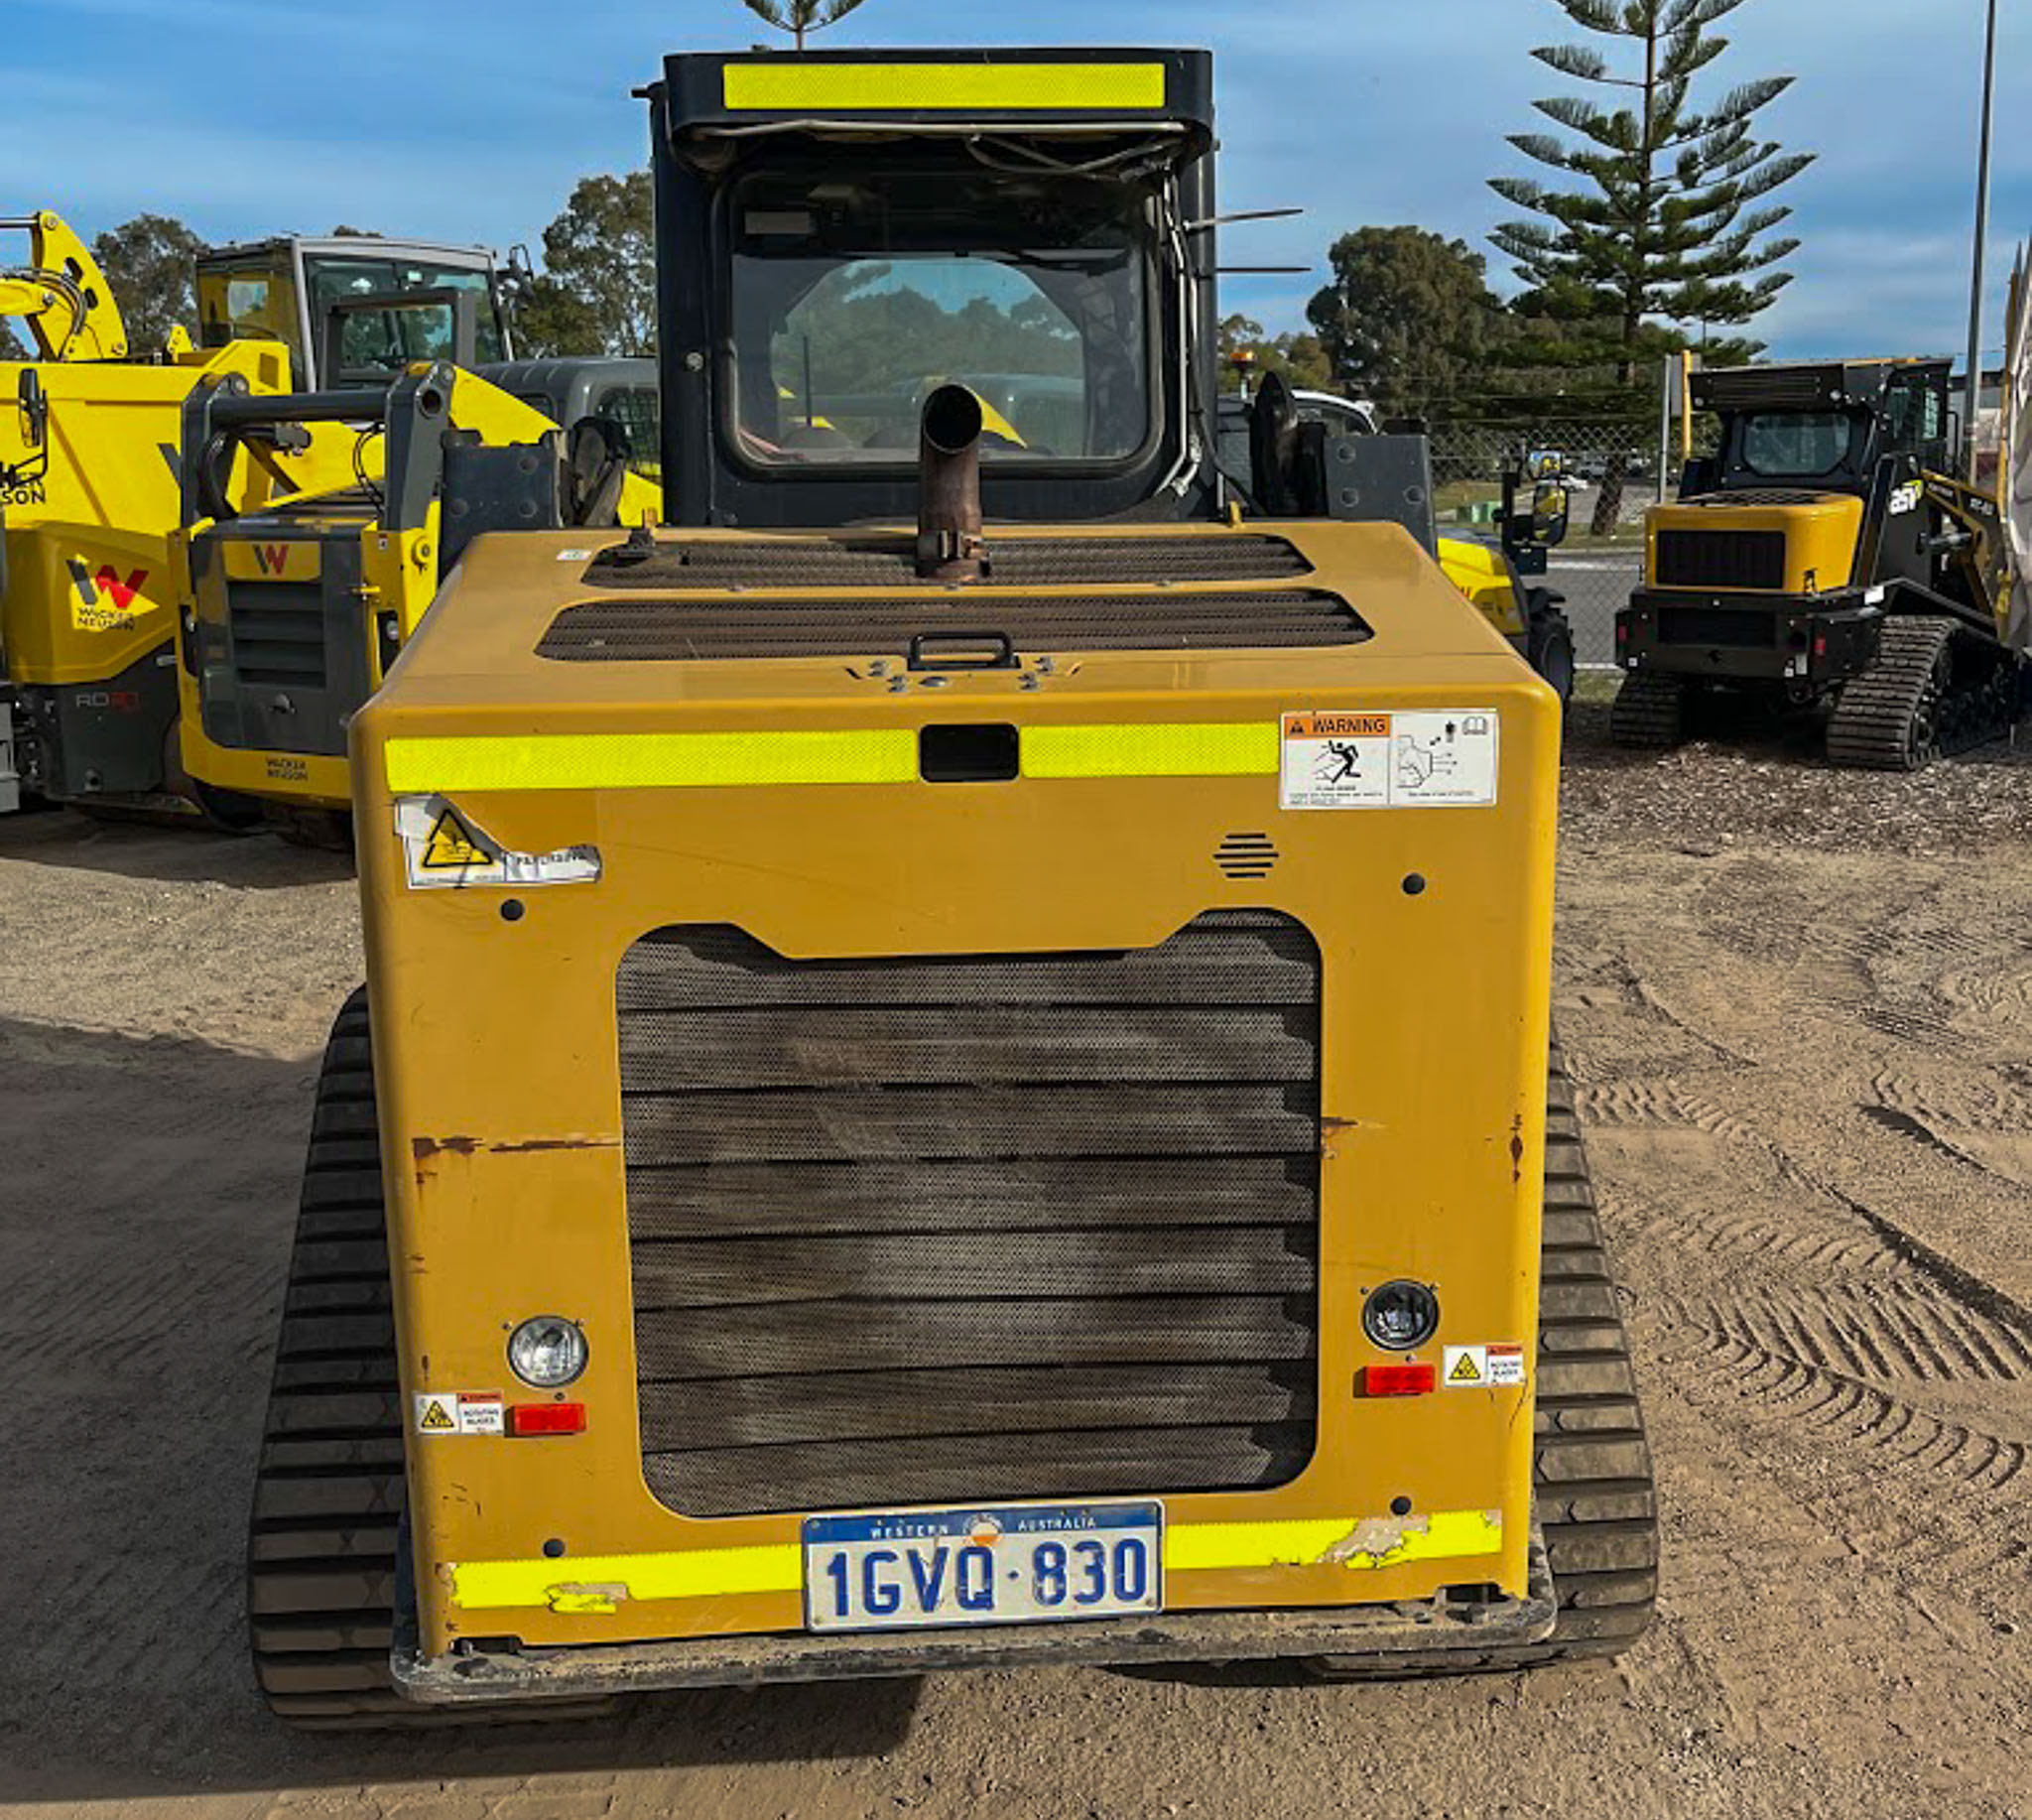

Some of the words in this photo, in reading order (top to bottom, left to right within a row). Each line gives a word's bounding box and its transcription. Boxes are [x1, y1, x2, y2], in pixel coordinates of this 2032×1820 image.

[1313, 718, 1386, 733] WARNING
[869, 1524, 949, 1540] WESTERN
[1017, 1516, 1096, 1532] AUSTRALIA
